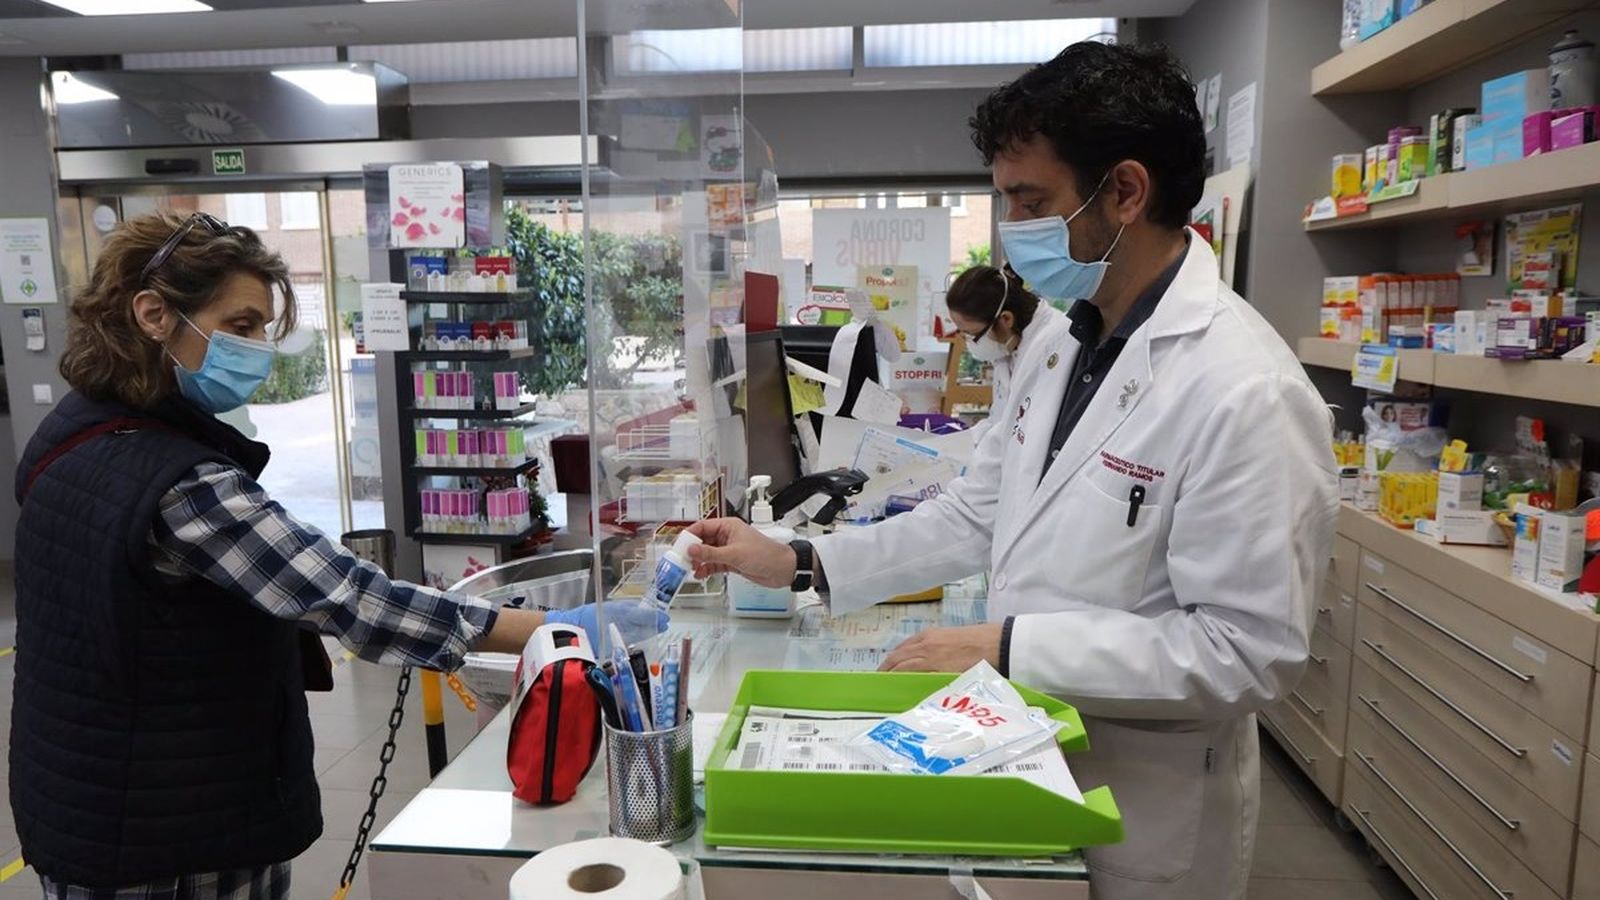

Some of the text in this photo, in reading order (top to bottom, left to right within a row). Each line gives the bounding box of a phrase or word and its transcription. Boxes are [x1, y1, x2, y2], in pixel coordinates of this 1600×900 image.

[214, 155, 243, 169] SALIDA
[398, 167, 452, 177] GENERICS
[895, 370, 943, 379] STOPFRI
[1128, 470, 1153, 482] RAMOS
[1137, 464, 1165, 478] TITULAR
